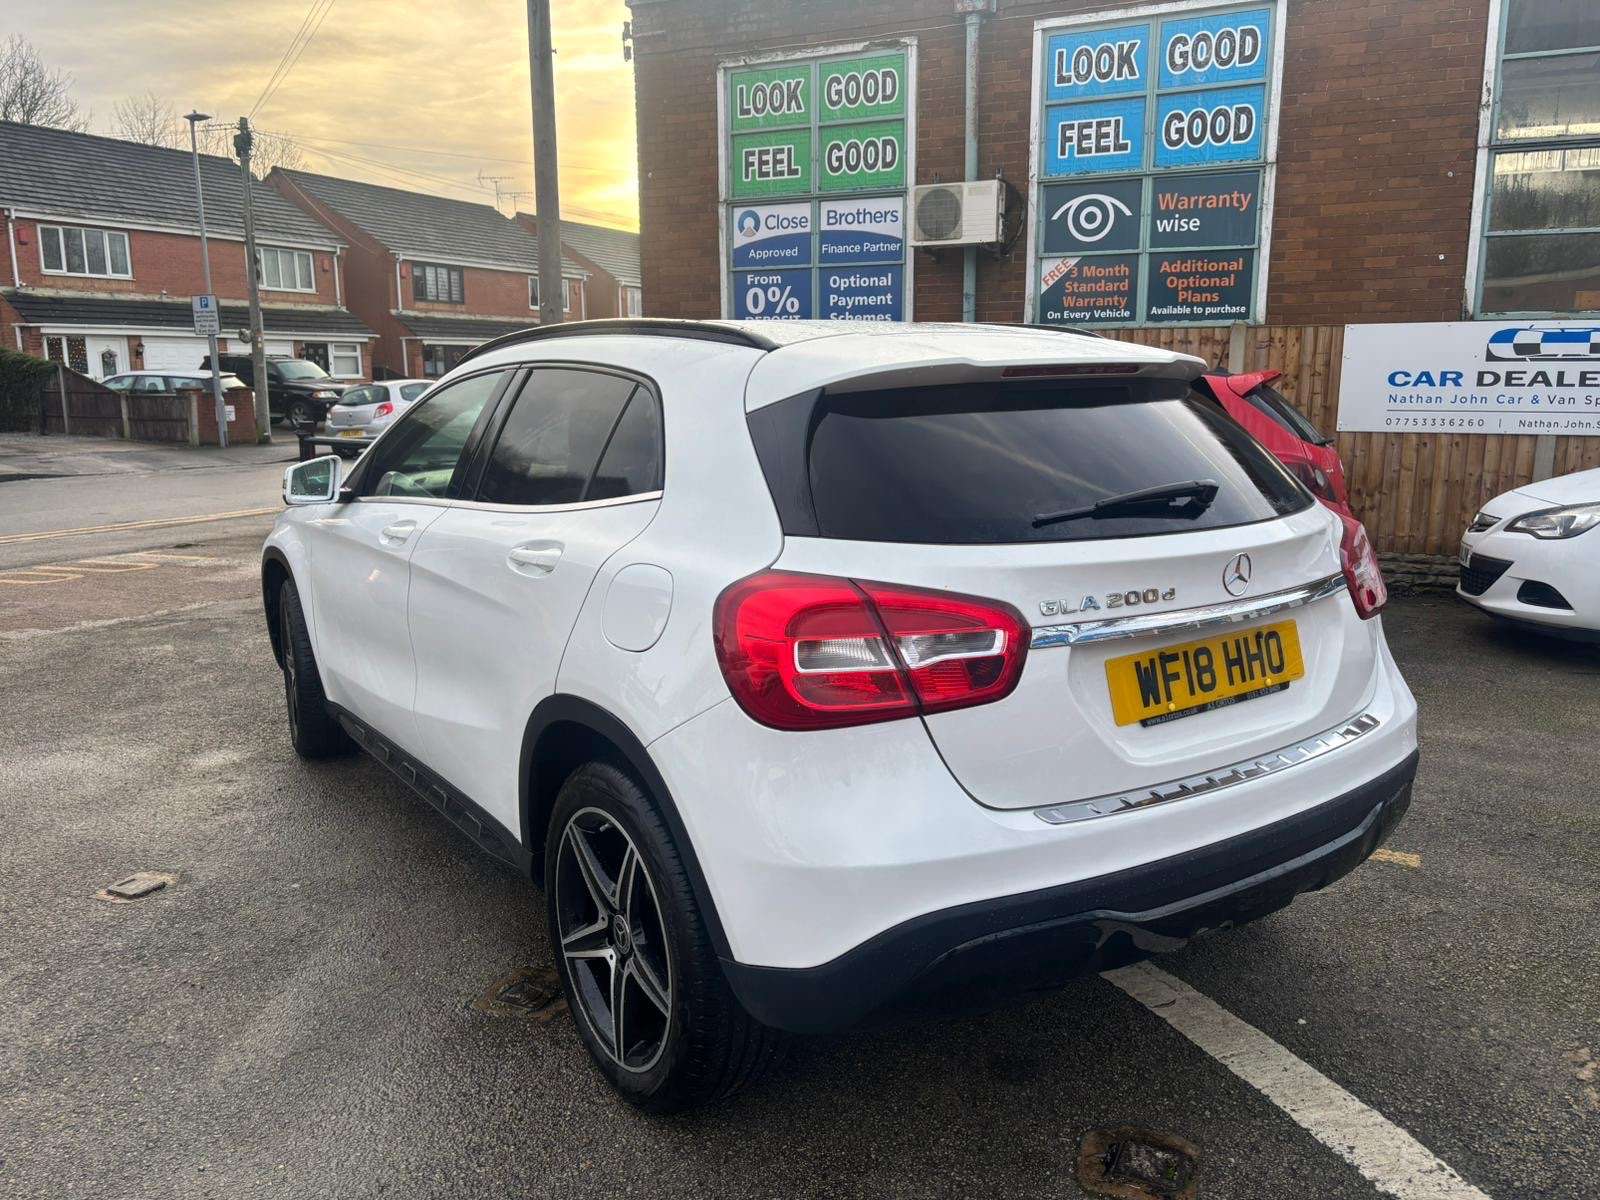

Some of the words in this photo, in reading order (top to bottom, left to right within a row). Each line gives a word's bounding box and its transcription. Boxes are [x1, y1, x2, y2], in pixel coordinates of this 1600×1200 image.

[1054, 40, 1140, 87] LOOK
[1166, 26, 1260, 75] GOOD
[737, 79, 804, 118] LOOK
[826, 69, 898, 110] GOOD
[1058, 116, 1131, 159] FEEL
[1162, 104, 1256, 150] GOOD
[742, 145, 801, 181] FEEL
[826, 137, 898, 175] GOOD
[1158, 191, 1252, 212] Warranty
[764, 214, 808, 230] Close
[826, 208, 898, 226] Brothers
[1157, 215, 1200, 232] wise
[748, 246, 798, 260] Approved
[822, 243, 860, 254] Finance
[863, 242, 901, 252] Partner
[1043, 258, 1073, 287] FREE
[1071, 266, 1078, 278] 3
[1083, 264, 1129, 277] Month
[1160, 258, 1243, 273] Additional
[747, 274, 782, 284] From
[829, 273, 892, 290] Optional
[1064, 279, 1129, 293] Standard
[1167, 274, 1235, 289] Optional
[746, 286, 800, 314] 0%
[830, 293, 892, 309] Payment
[1063, 296, 1127, 309] Warranty
[1178, 290, 1220, 303] Plans
[1048, 310, 1061, 319] On
[1064, 310, 1091, 321] Every
[1094, 309, 1130, 318] Vehicle
[1151, 306, 1191, 315] Available
[1193, 306, 1202, 314] to
[1205, 305, 1246, 315] purchase
[1387, 371, 1464, 387] CAR
[1476, 371, 1600, 387] DEALE
[1389, 394, 1442, 404] Nathan
[1450, 394, 1488, 404] John
[1496, 394, 1523, 405] Car
[1530, 395, 1540, 405] &
[1548, 395, 1576, 405] Van
[1386, 418, 1485, 427] 07753336260
[1039, 595, 1101, 616] GLA
[1106, 588, 1176, 608] 200d
[1134, 646, 1217, 708] WF18
[1222, 630, 1285, 686] HHO
